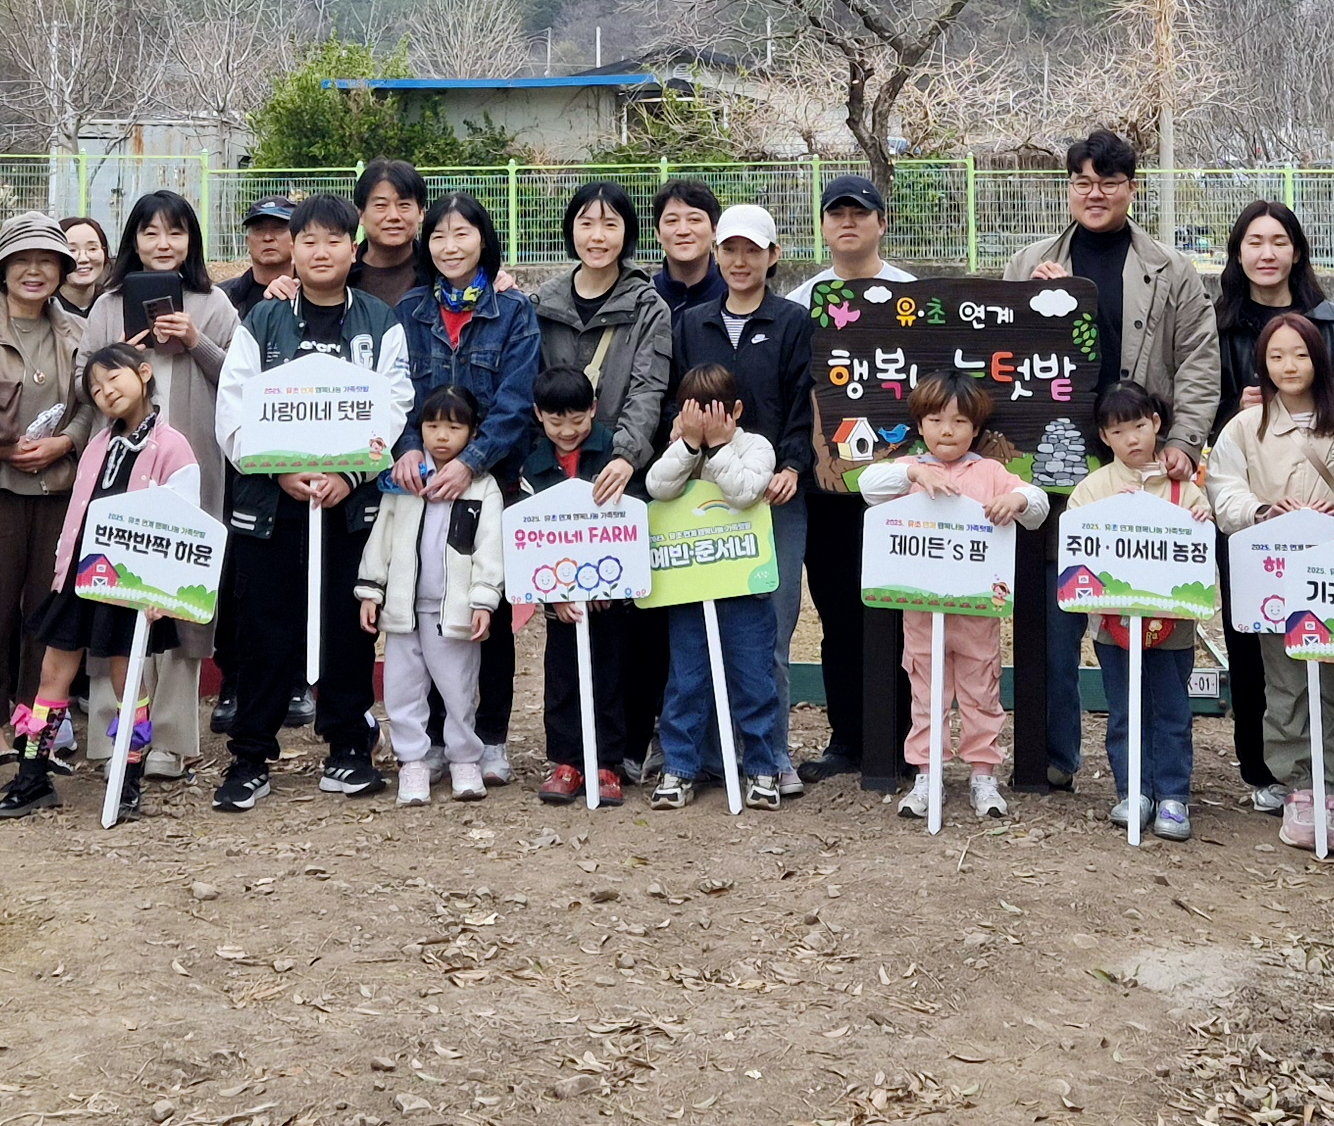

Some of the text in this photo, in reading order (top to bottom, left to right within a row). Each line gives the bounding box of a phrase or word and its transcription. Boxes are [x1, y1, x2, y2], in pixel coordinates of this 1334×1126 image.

[896, 297, 1013, 329] 유·초 연계
[259, 399, 374, 422] 사랑이네 텃밭
[95, 524, 213, 567] 반짝반짝 하윤
[515, 525, 637, 550] 유안이네 FARM
[650, 534, 757, 569] 예빈·준서네
[969, 540, 988, 562] 팜
[1173, 541, 1208, 564] 농장
